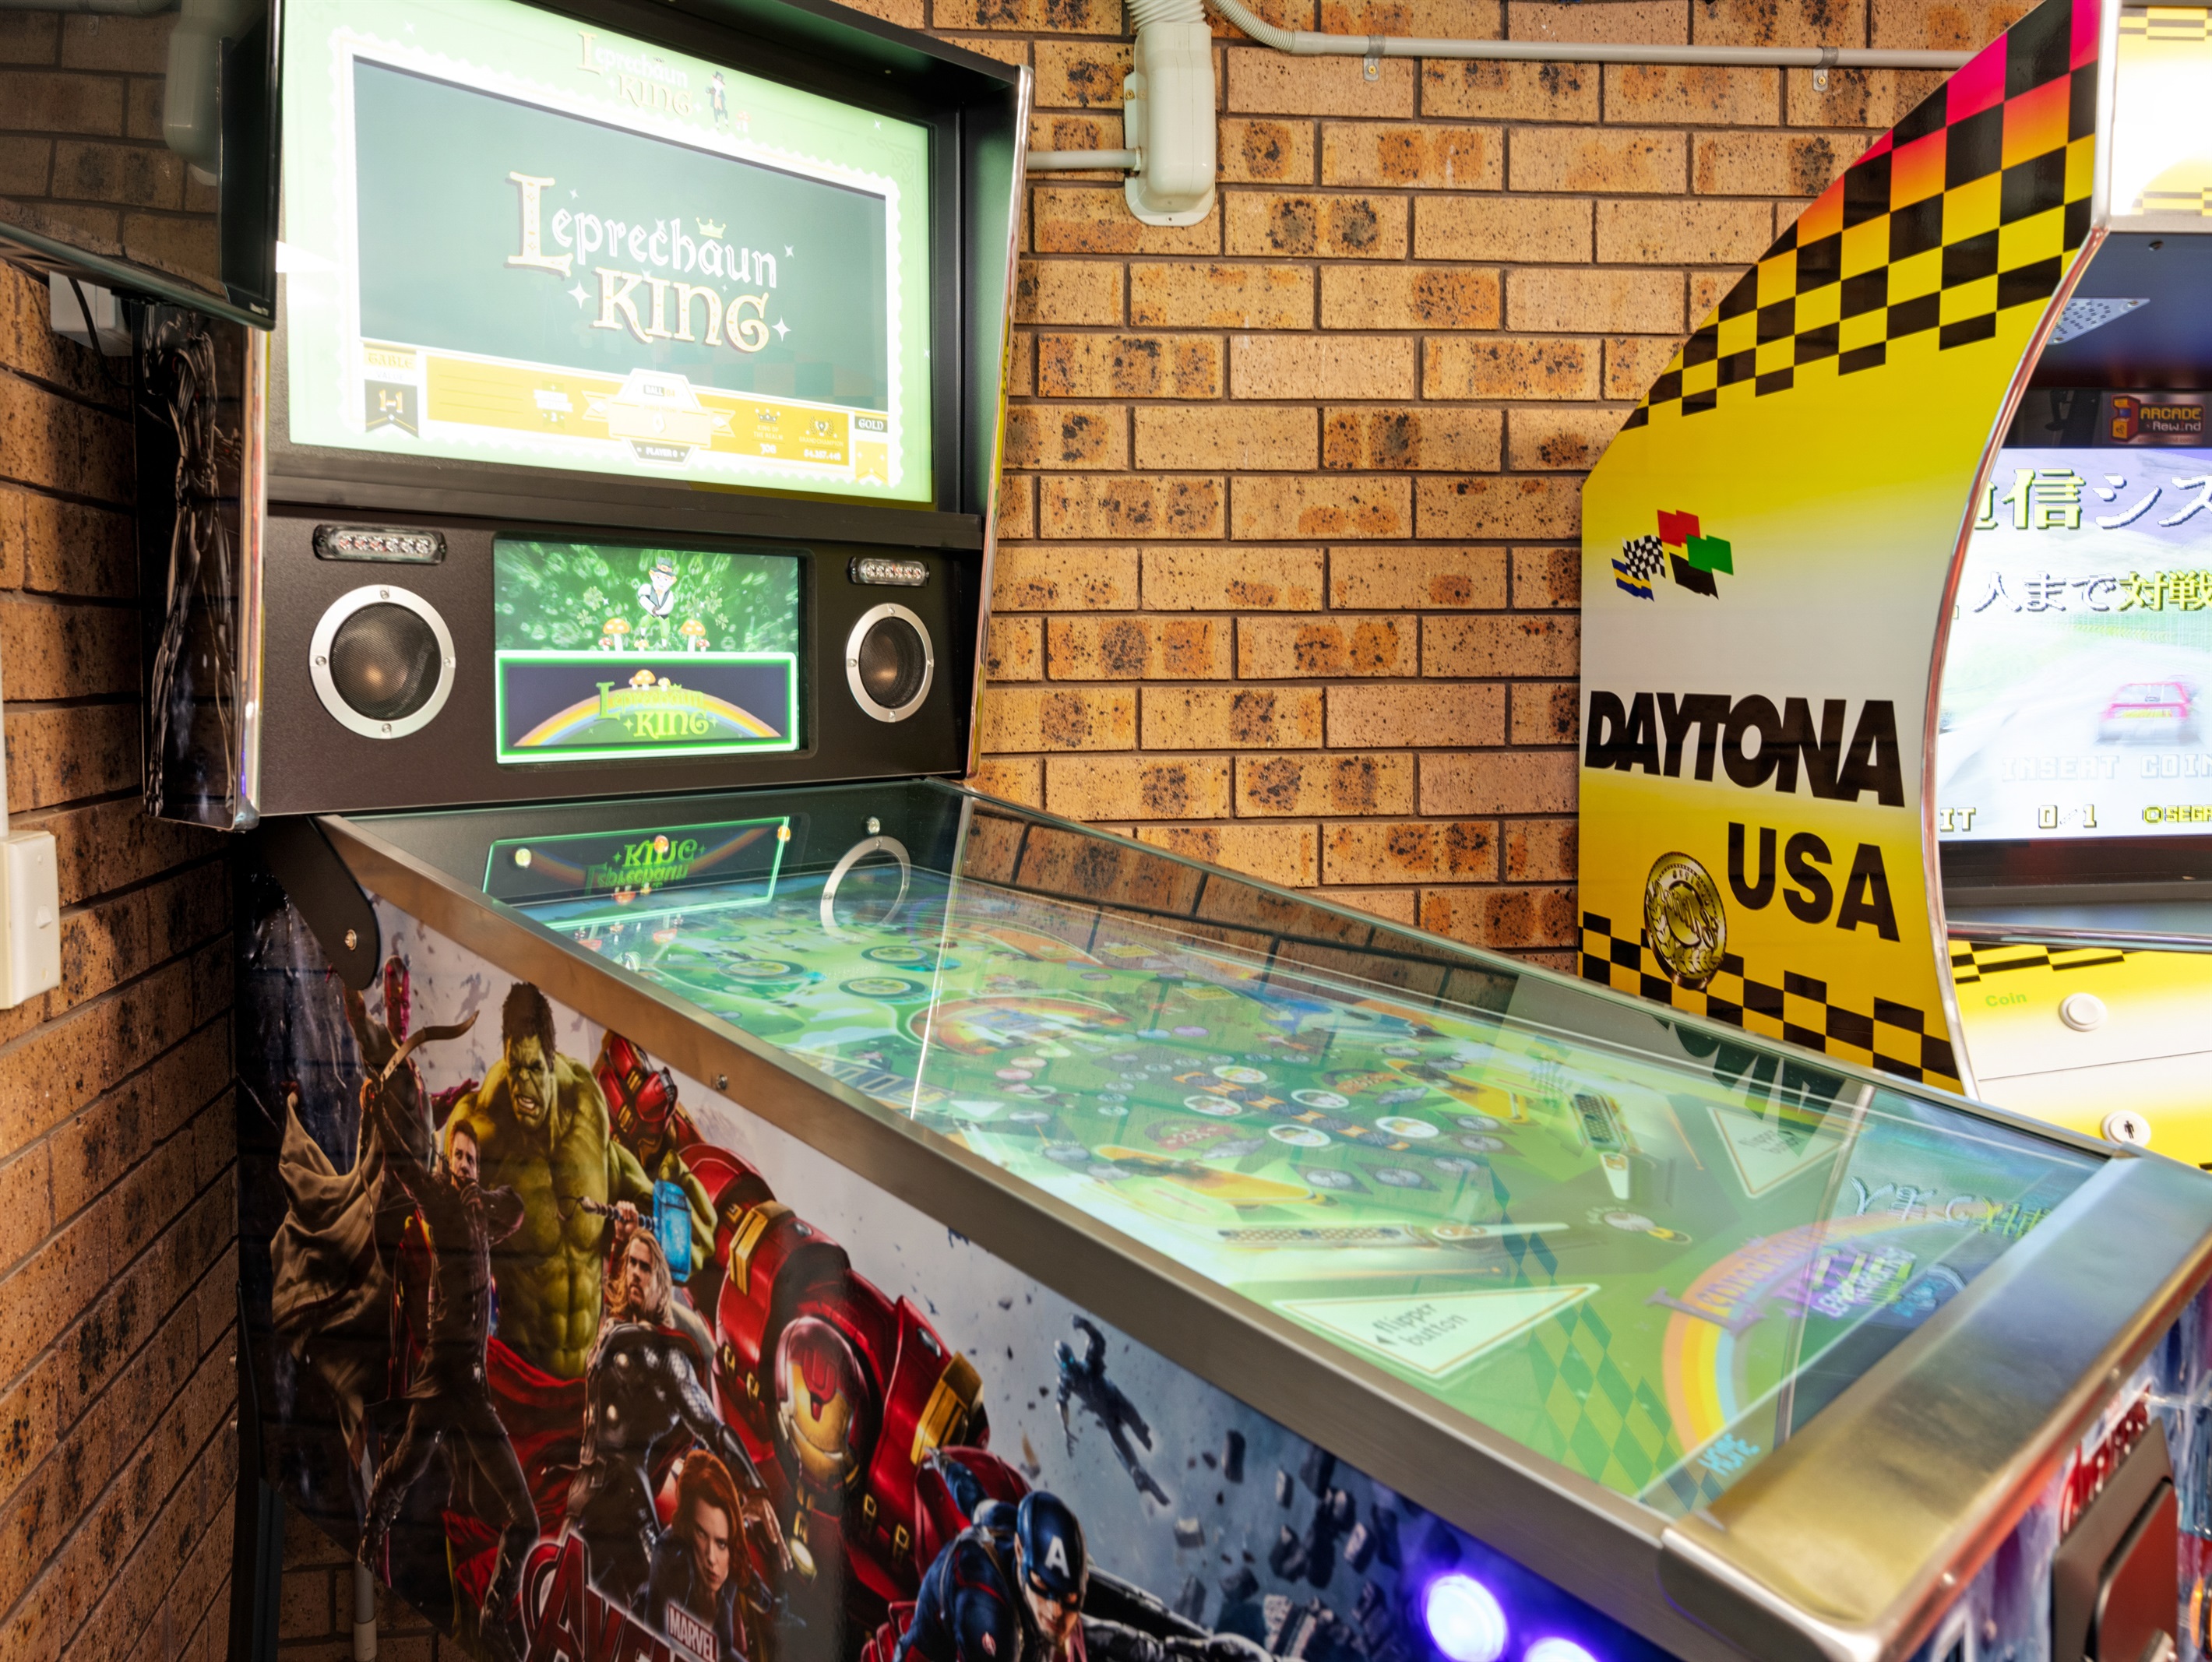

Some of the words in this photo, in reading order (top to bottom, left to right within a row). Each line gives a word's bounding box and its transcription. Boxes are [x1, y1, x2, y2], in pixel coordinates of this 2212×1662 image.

[576, 30, 689, 88] Leprechaun
[618, 72, 692, 117] KING
[505, 171, 777, 289] Leprechaun
[590, 266, 770, 353] KING
[858, 418, 884, 431] GOLD
[2140, 407, 2202, 421] ARCADE
[646, 446, 671, 458] PLAYER
[595, 681, 706, 721] Leprechaun
[633, 710, 710, 740] KING
[1584, 689, 1906, 808] DAYTONA
[2002, 755, 2120, 782] INSERT
[1727, 821, 1901, 943] USA
[1985, 991, 2028, 1007] Coin
[1372, 1302, 1437, 1334] flipper
[1398, 1313, 1469, 1347] button
[669, 1605, 717, 1662] MARVEL
